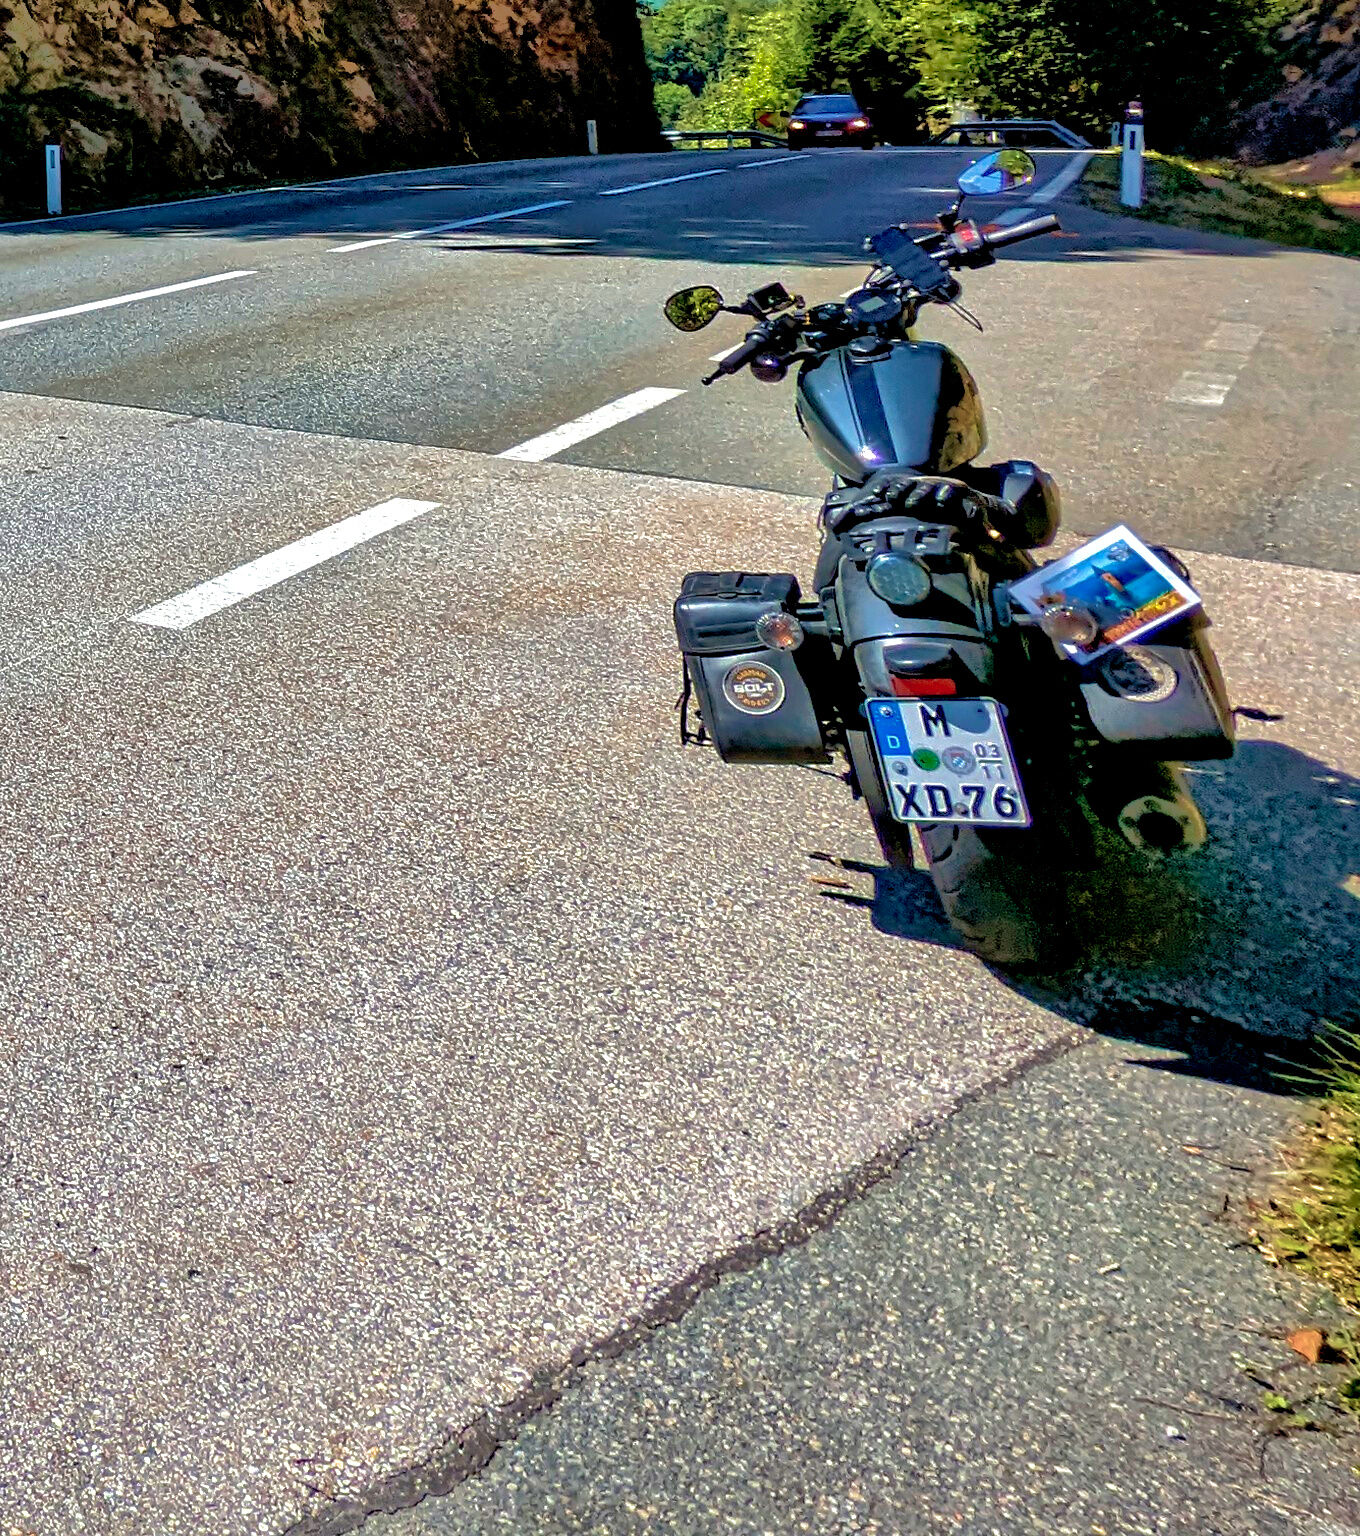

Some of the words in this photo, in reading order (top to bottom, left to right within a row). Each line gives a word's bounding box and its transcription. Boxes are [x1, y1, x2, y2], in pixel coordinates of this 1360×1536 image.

[733, 682, 775, 694] BOLT
[918, 704, 952, 738] M
[886, 735, 901, 750] D
[973, 742, 1001, 759] 03
